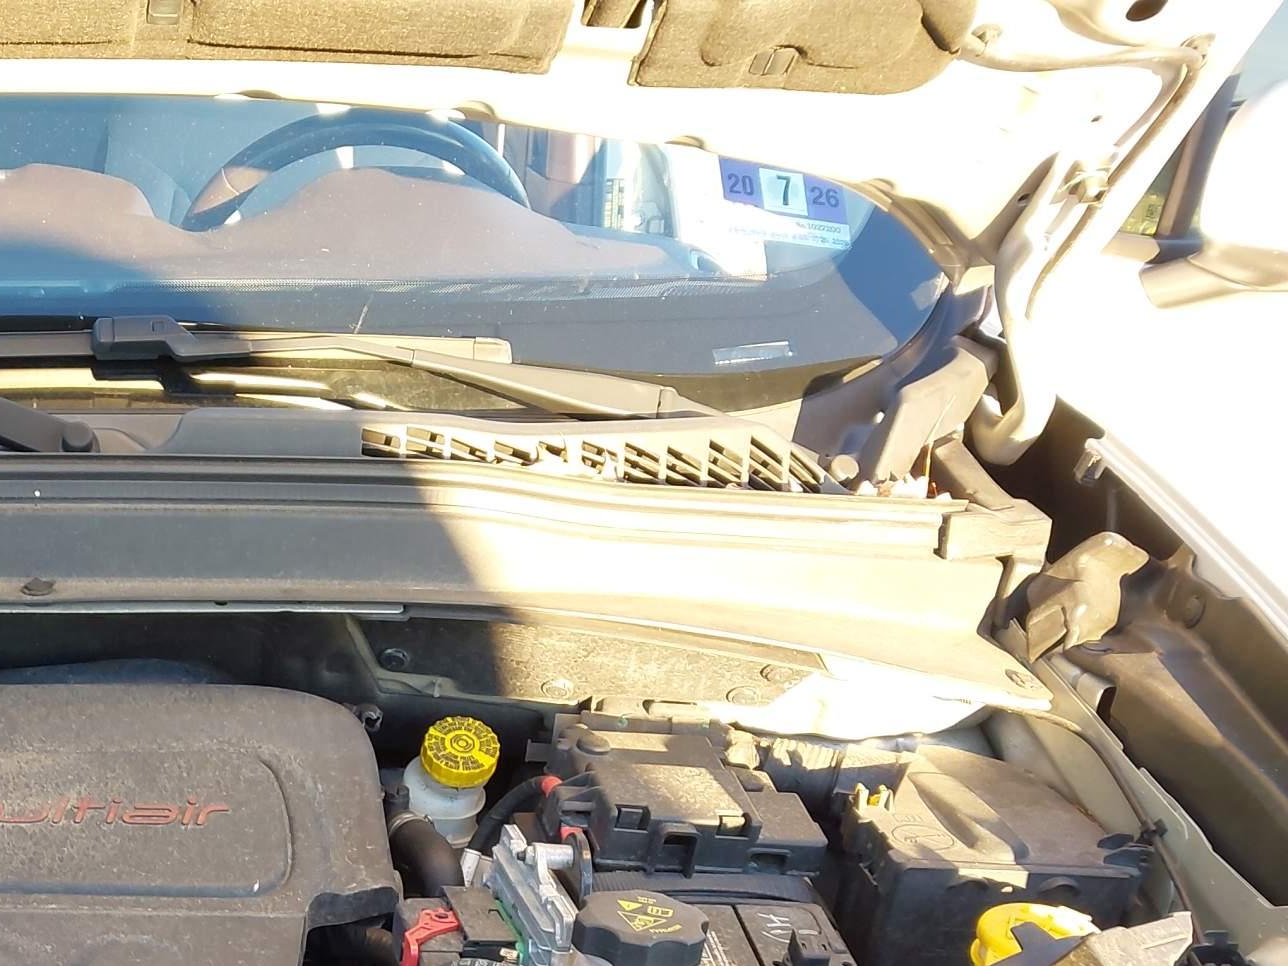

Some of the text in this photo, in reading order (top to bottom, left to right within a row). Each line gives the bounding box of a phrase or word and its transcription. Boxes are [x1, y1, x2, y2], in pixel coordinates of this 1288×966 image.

[727, 173, 840, 208] 20 7 26
